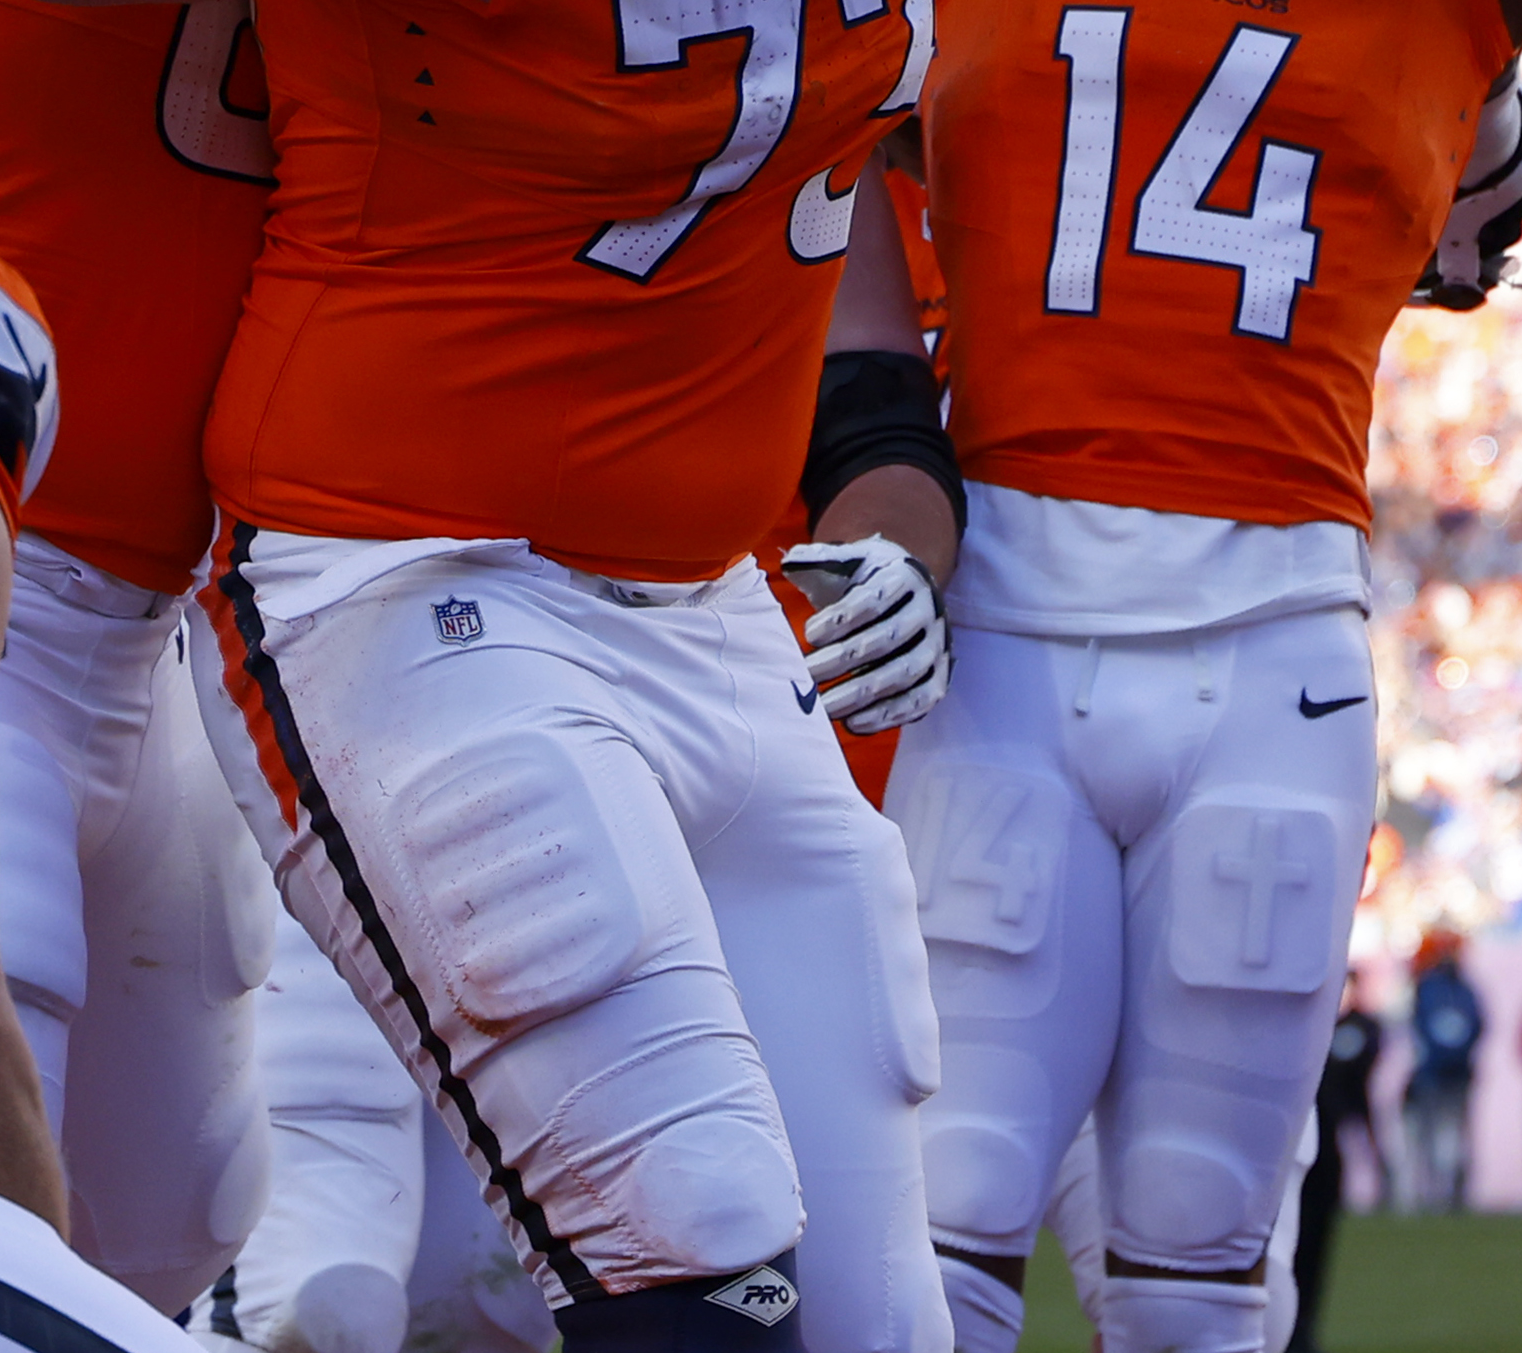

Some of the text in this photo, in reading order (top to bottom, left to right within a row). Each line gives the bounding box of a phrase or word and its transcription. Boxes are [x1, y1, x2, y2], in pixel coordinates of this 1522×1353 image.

[1044, 4, 1323, 345] 14
[442, 615, 478, 636] NFL
[741, 1284, 790, 1305] PRO
